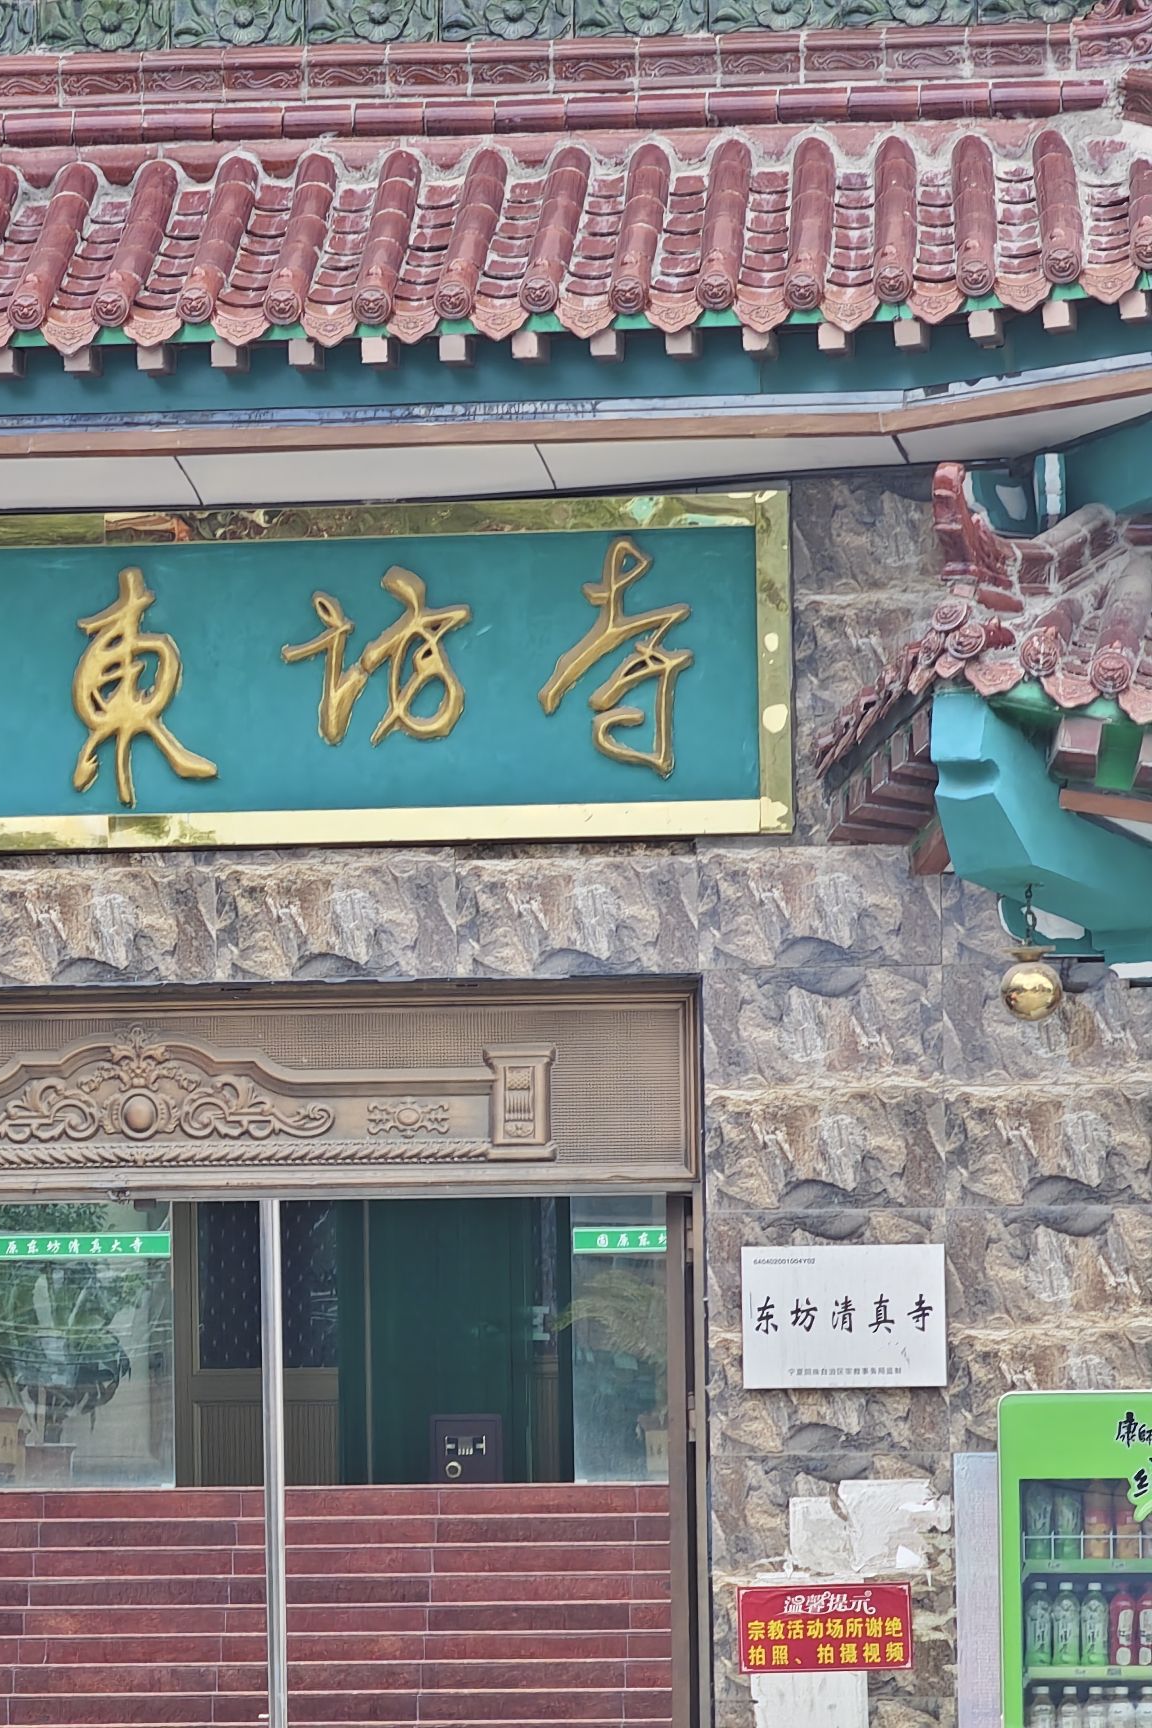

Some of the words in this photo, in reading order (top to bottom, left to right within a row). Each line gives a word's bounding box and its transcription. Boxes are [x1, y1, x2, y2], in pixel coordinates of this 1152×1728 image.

[754, 1293, 934, 1335] 东坊清真寺
[780, 1590, 877, 1615] 温馨提示
[748, 1616, 904, 1641] 宗教活动场所谢绝
